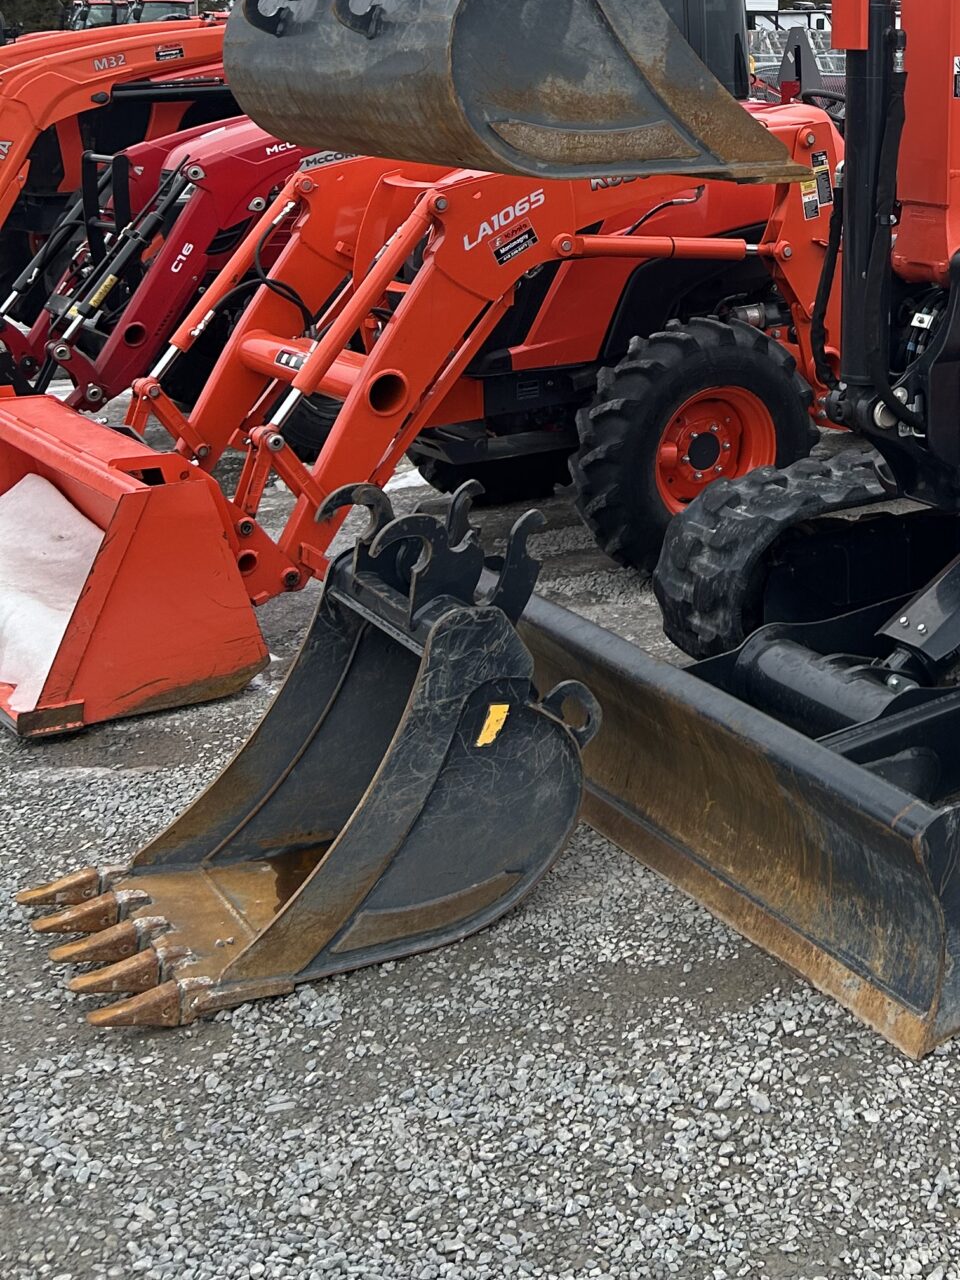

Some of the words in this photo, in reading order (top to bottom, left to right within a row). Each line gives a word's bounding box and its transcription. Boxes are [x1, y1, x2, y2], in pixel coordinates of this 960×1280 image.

[93, 53, 127, 71] M32
[463, 187, 546, 251] LA1065
[170, 242, 194, 273] C16
